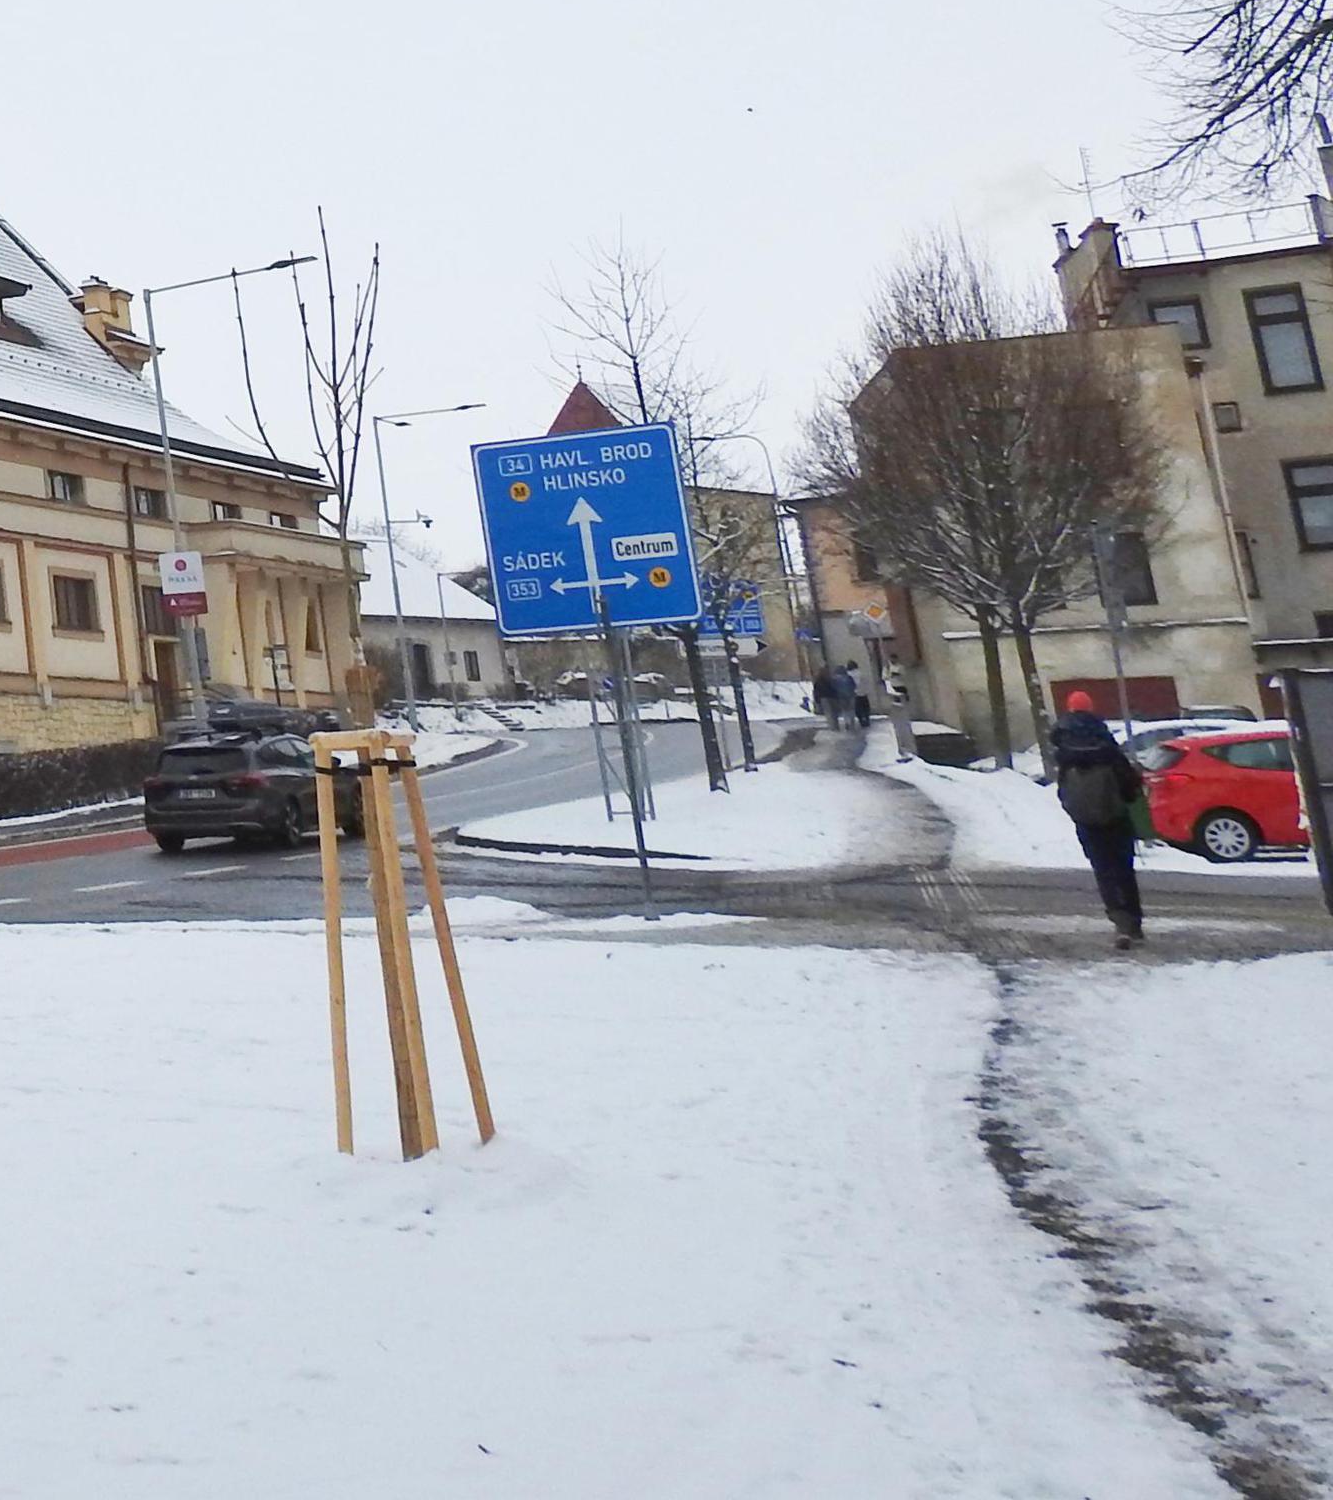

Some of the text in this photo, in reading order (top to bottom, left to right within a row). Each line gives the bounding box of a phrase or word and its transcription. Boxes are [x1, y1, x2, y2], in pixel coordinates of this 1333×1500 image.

[506, 458, 525, 472] 34
[599, 442, 652, 463] BROD
[543, 467, 626, 491] HLINSKO
[615, 539, 674, 557] Centrum
[502, 550, 566, 572] SÁDEK
[510, 582, 537, 597] 353
